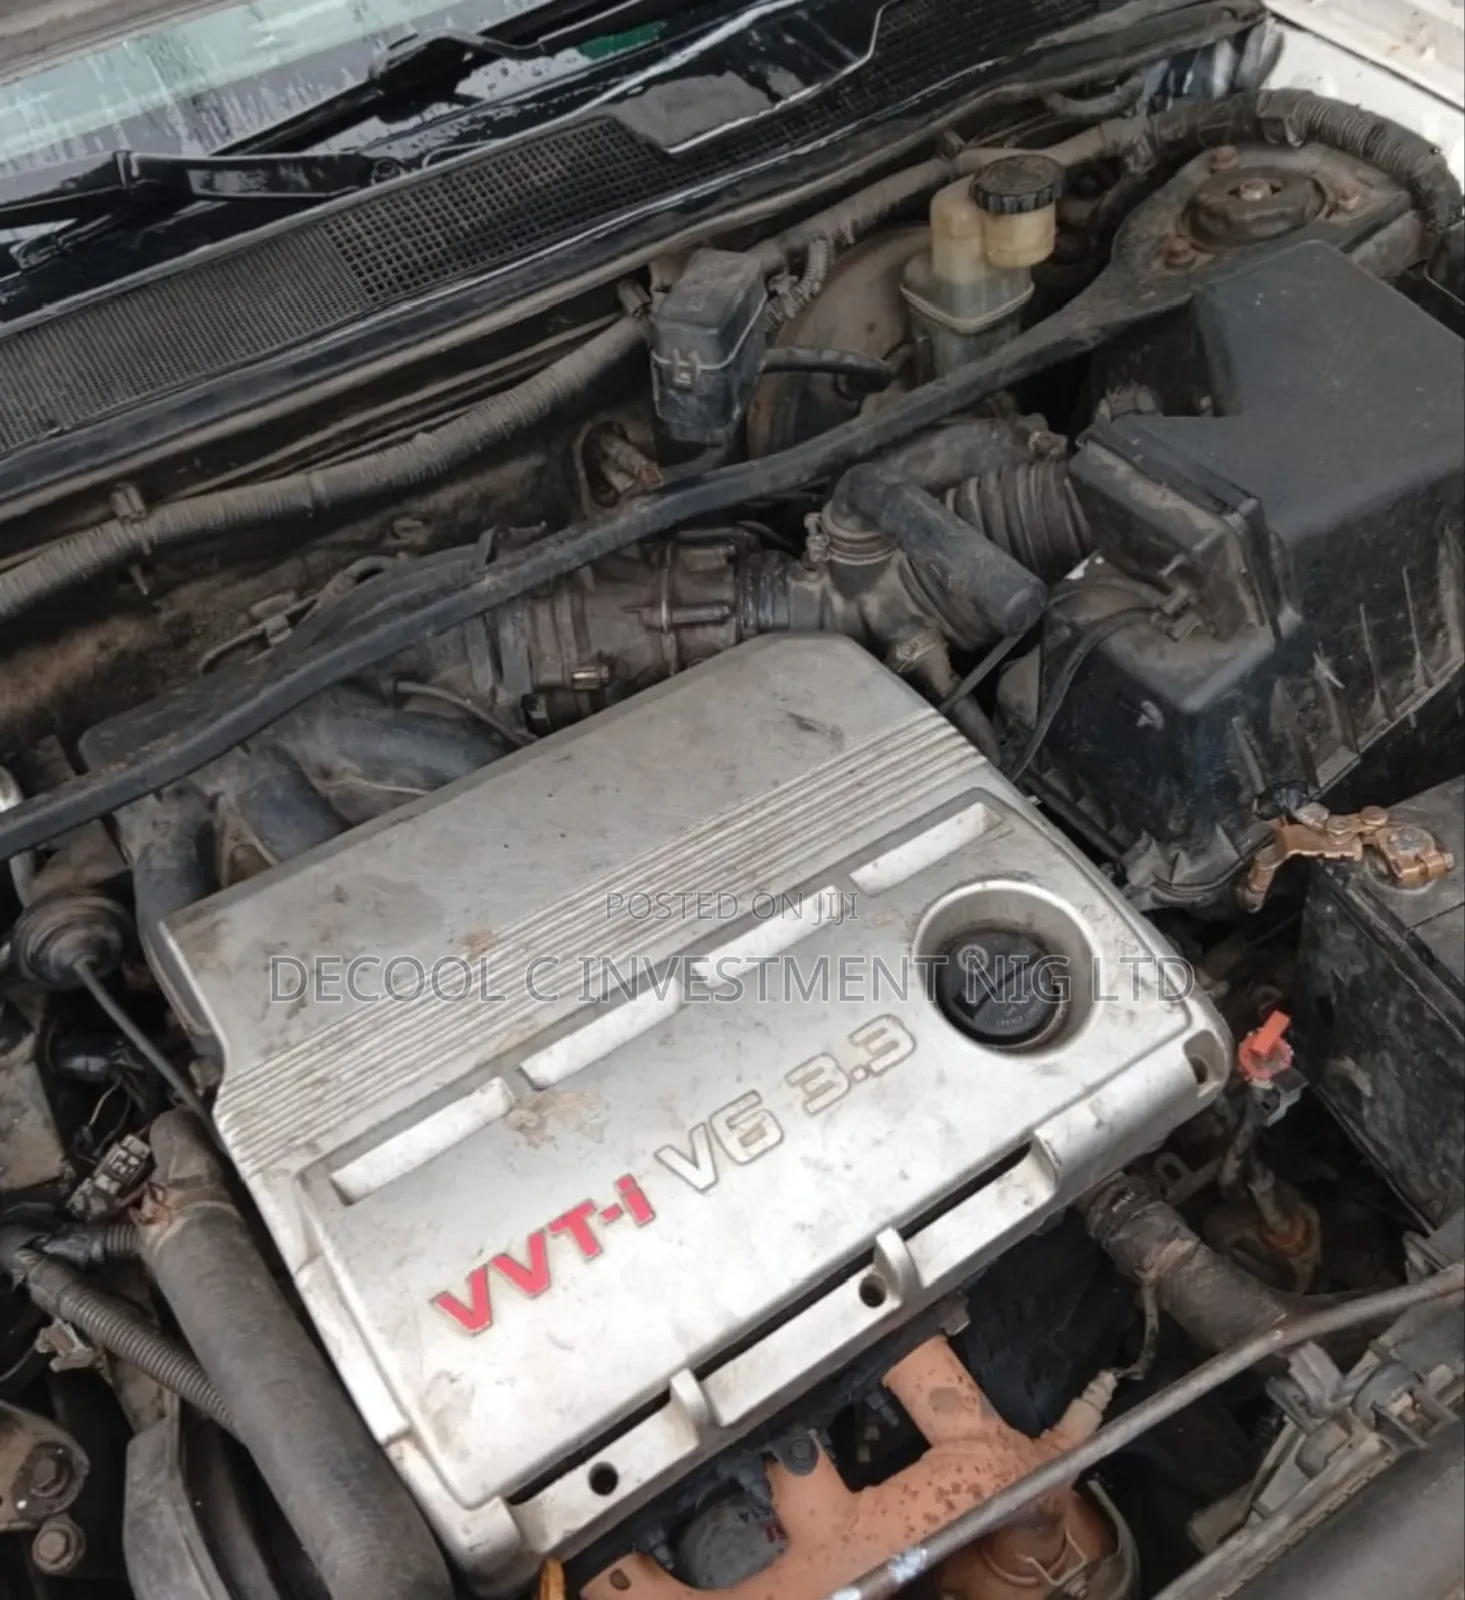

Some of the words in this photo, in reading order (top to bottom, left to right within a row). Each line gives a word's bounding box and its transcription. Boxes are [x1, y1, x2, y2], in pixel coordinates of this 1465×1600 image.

[432, 1172, 657, 1336] VVT-i
[654, 1089, 784, 1195] V6
[785, 1012, 917, 1117] 3.3
